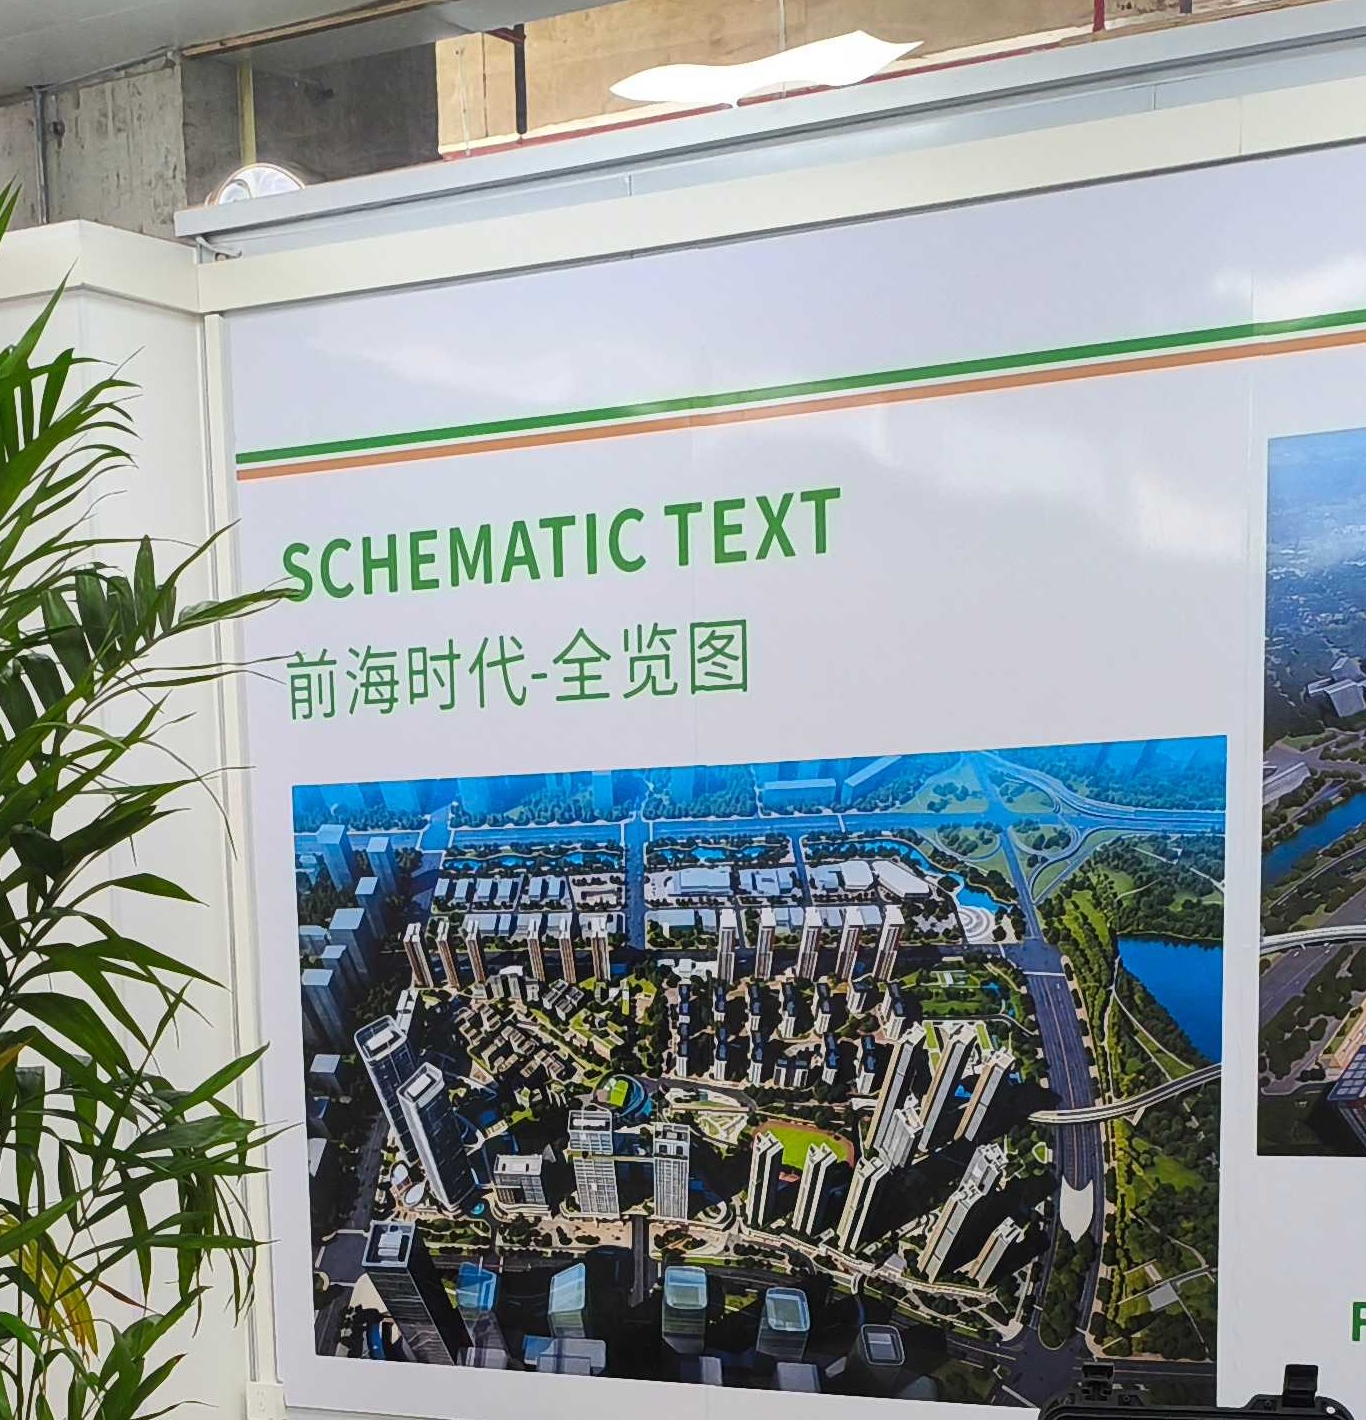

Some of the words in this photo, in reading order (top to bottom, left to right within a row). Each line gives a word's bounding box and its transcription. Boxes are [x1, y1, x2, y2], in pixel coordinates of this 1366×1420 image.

[282, 508, 647, 602] SCHEMATIC
[664, 488, 843, 567] TEXT
[286, 618, 749, 721] 前海时代-全览图
